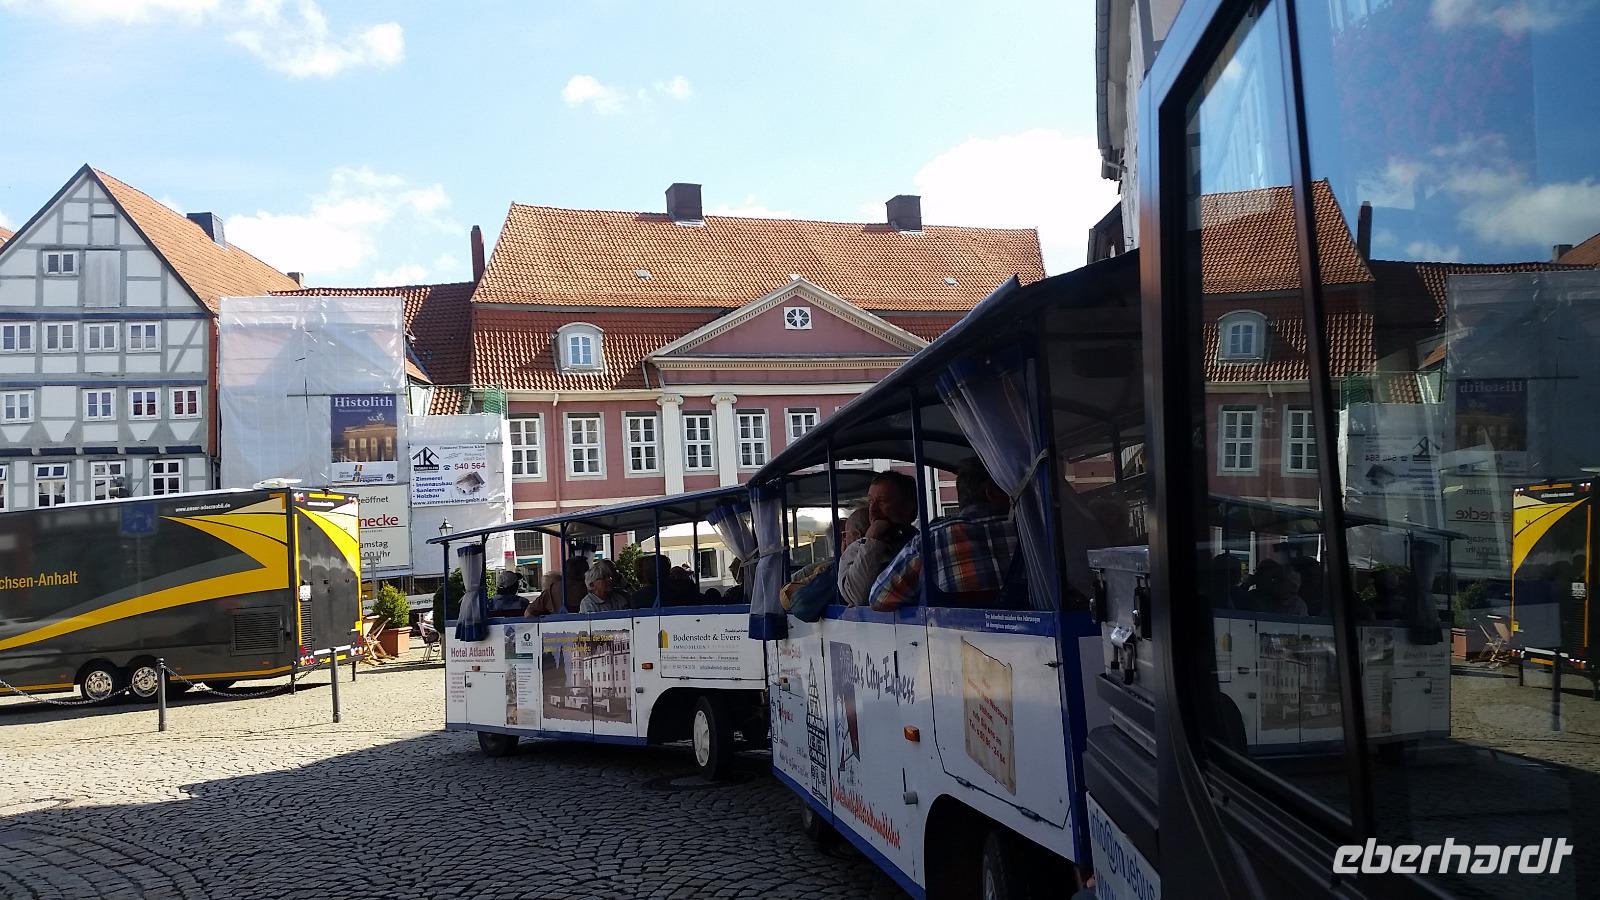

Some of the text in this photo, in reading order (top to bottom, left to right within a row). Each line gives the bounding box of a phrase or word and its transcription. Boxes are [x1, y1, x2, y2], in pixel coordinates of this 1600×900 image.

[334, 396, 393, 407] Histolith
[454, 462, 486, 470] 540 564
[0, 570, 78, 589] chsen-Anhalt
[451, 646, 495, 657] Hotel Atlantik
